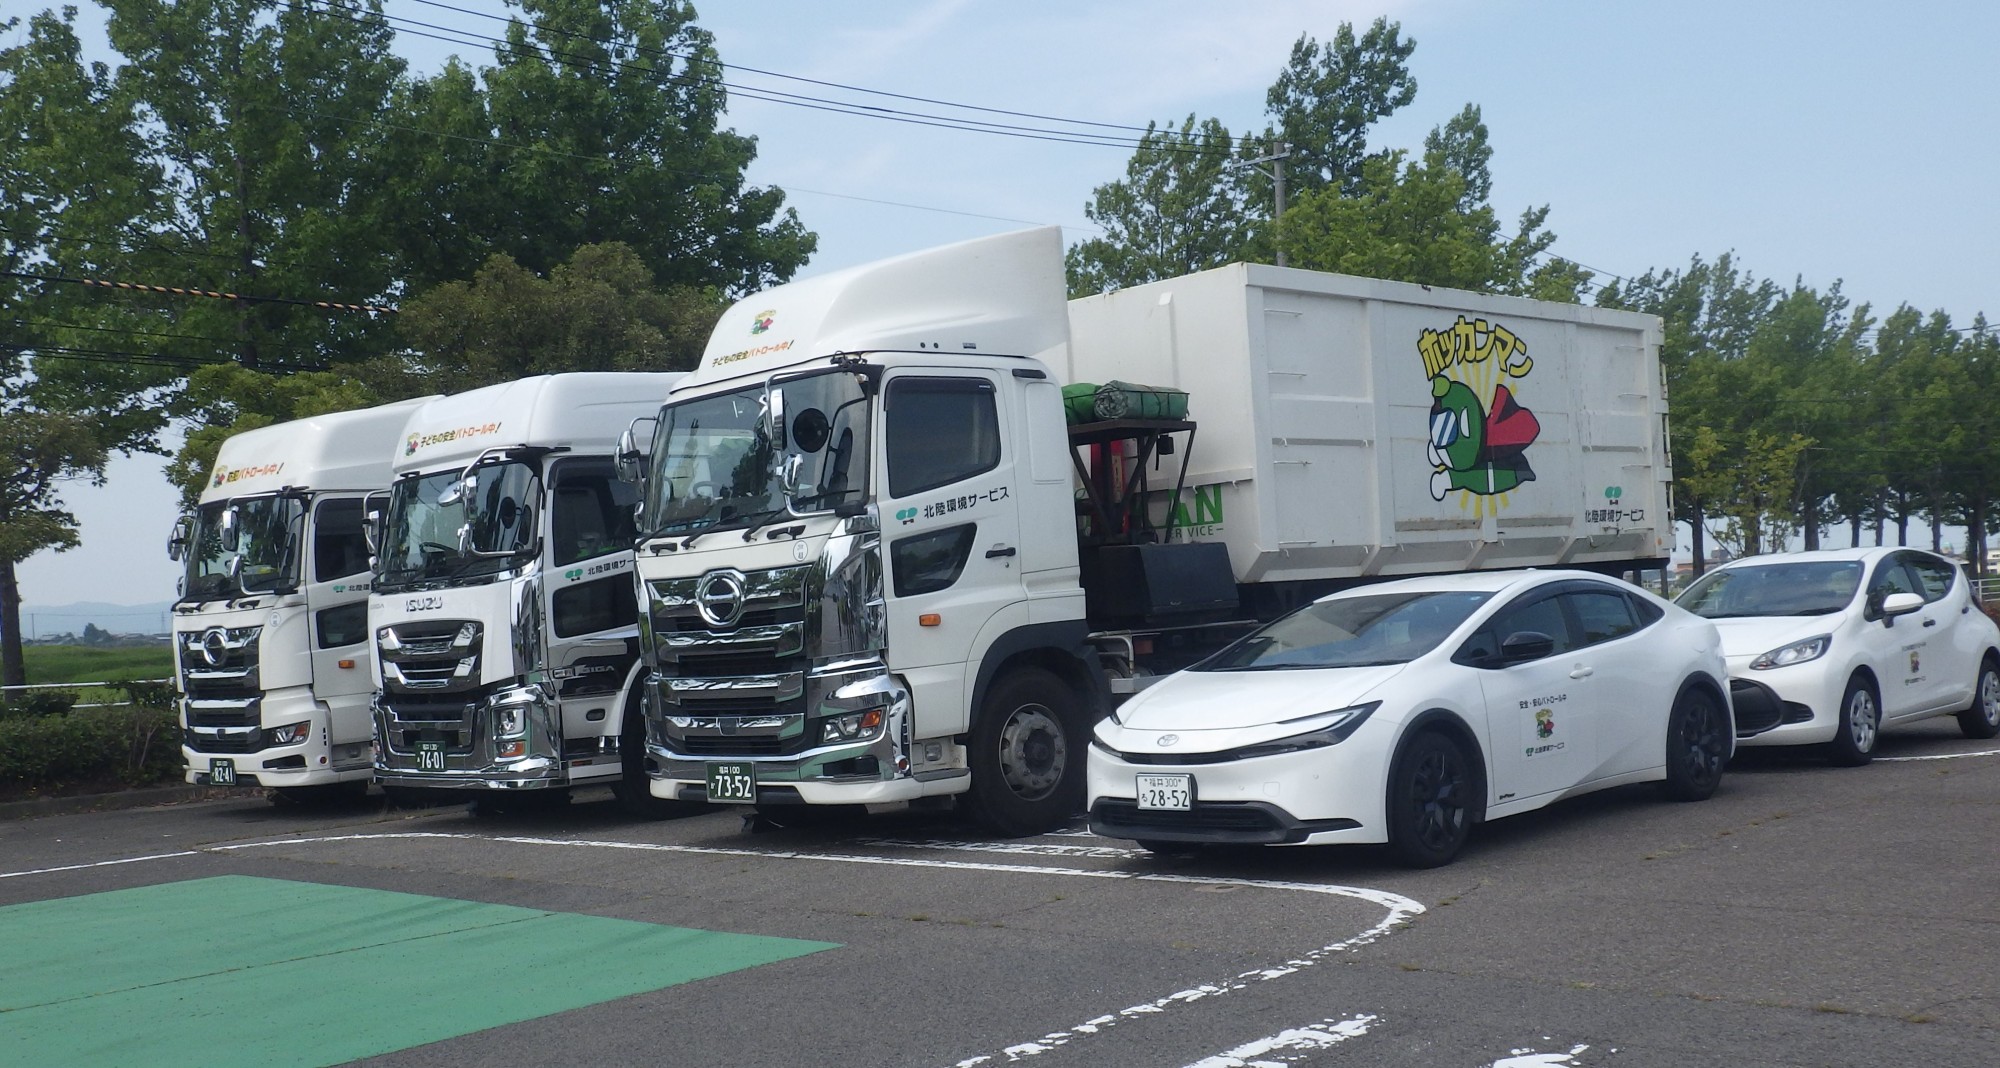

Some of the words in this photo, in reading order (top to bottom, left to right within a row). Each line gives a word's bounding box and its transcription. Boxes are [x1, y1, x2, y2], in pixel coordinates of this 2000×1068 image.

[1417, 315, 1533, 381] ホッカンマン
[923, 486, 1010, 519] 北陸環境サービス
[1584, 508, 1645, 523] 北陸環境サービス
[405, 596, 443, 612] ISUZU
[419, 751, 444, 769] 76-01
[715, 775, 752, 797] 73-52
[1149, 789, 1189, 807] 28-52
